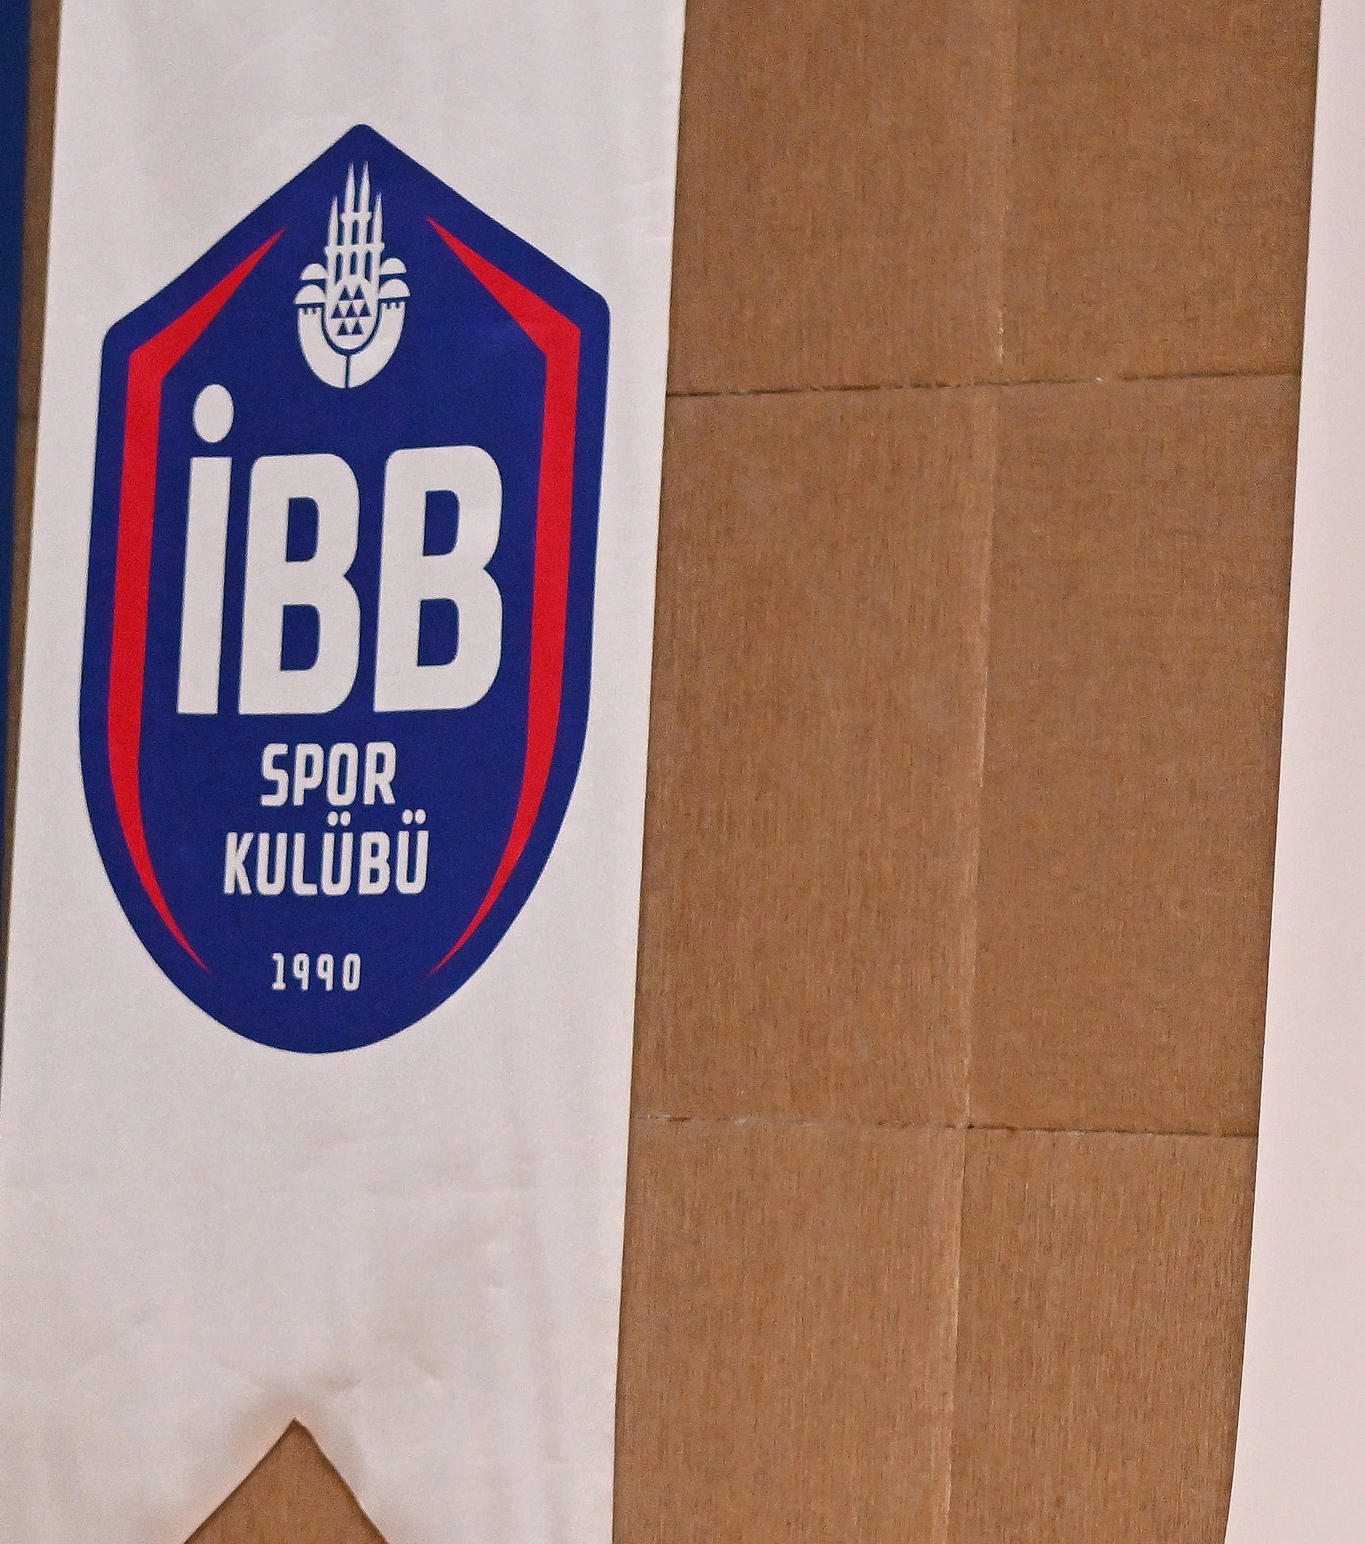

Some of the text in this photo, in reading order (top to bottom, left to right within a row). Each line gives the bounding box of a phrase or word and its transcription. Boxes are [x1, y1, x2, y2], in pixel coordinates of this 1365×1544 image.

[176, 383, 504, 715] İBB
[259, 740, 398, 807] SPOR
[223, 810, 429, 897] KULÜBÜ
[271, 952, 362, 993] 1990
